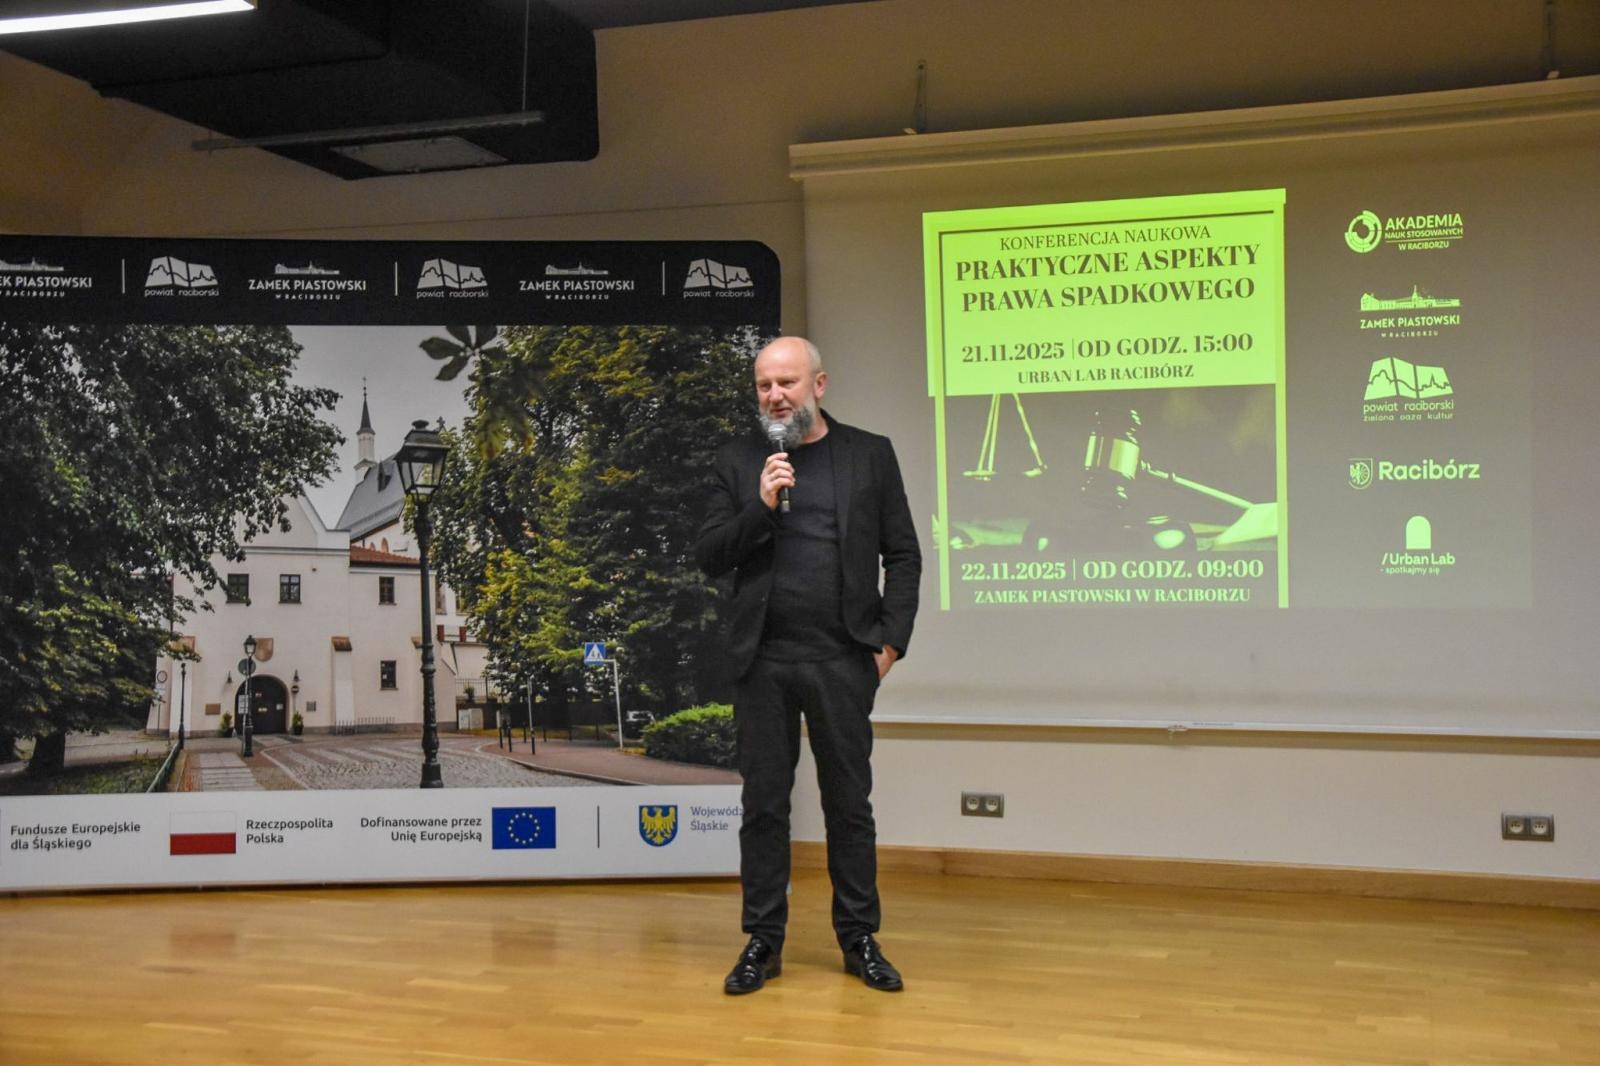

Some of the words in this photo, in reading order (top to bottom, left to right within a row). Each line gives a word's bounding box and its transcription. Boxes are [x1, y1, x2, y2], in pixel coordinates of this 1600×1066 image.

[1385, 213, 1463, 231] AKADEMIA
[1000, 230, 1119, 251] KONFERENCJA
[1125, 225, 1211, 244] NAUKOWA
[1385, 231, 1406, 239] NAUK
[1407, 228, 1463, 239] STOSOWANYCH
[1408, 241, 1449, 250] RACIBORZU
[955, 252, 1128, 281] PRAKTYCZNE
[1136, 244, 1261, 272] ASPEKTY
[15, 276, 92, 288] PIASTOWSKI
[248, 279, 291, 290] ZAMEK
[294, 280, 366, 291] PIASTOWSKI
[519, 280, 561, 291] ZAMEK
[564, 280, 635, 291] PIASTOWSKI
[144, 287, 174, 297] powiat
[178, 287, 219, 297] raciborski
[416, 289, 445, 299] powiat
[449, 289, 489, 298] raciborski
[683, 290, 711, 299] powiat
[715, 289, 754, 298] raciborski
[962, 287, 1054, 312] PRAWA
[1061, 277, 1255, 308] SPADKOWEGO
[1360, 317, 1395, 329] ZAMEK
[1398, 315, 1460, 327] PIASTOWSKI
[962, 342, 1065, 363] 21.11.2025
[1077, 340, 1111, 358] OD
[1117, 335, 1188, 357] GODZ.
[1194, 333, 1254, 353] 15:00
[1018, 370, 1072, 385] URBAN
[1075, 368, 1107, 382] LAB
[1110, 364, 1194, 381] RACIBÓRZ
[1363, 401, 1398, 415] powiat
[1404, 399, 1454, 411] raciborski
[1400, 413, 1422, 421] oaza
[1378, 458, 1480, 481] Racibórz
[1431, 552, 1456, 565] Lab
[961, 561, 1066, 581] 22.11.2025
[1083, 561, 1117, 579] OD
[1121, 560, 1192, 579] GODZ.
[1197, 559, 1264, 578] 09:00
[975, 590, 1029, 604] ZAMEK
[1033, 589, 1131, 603] PIASTOWSKI
[1136, 589, 1151, 602] W
[1154, 588, 1251, 602] RACIBORZU
[10, 823, 67, 836] Fundusze
[72, 821, 141, 836] Europejskie
[246, 817, 334, 832] Rzeczpospolita
[360, 816, 448, 829] Dofinansowane
[451, 817, 482, 829] przez
[690, 818, 729, 832] Śląskie
[246, 832, 284, 844] Polska
[391, 830, 417, 842] Unię
[420, 828, 482, 843] Europejską
[10, 838, 29, 850] dla
[32, 836, 92, 851] Śląskiego
